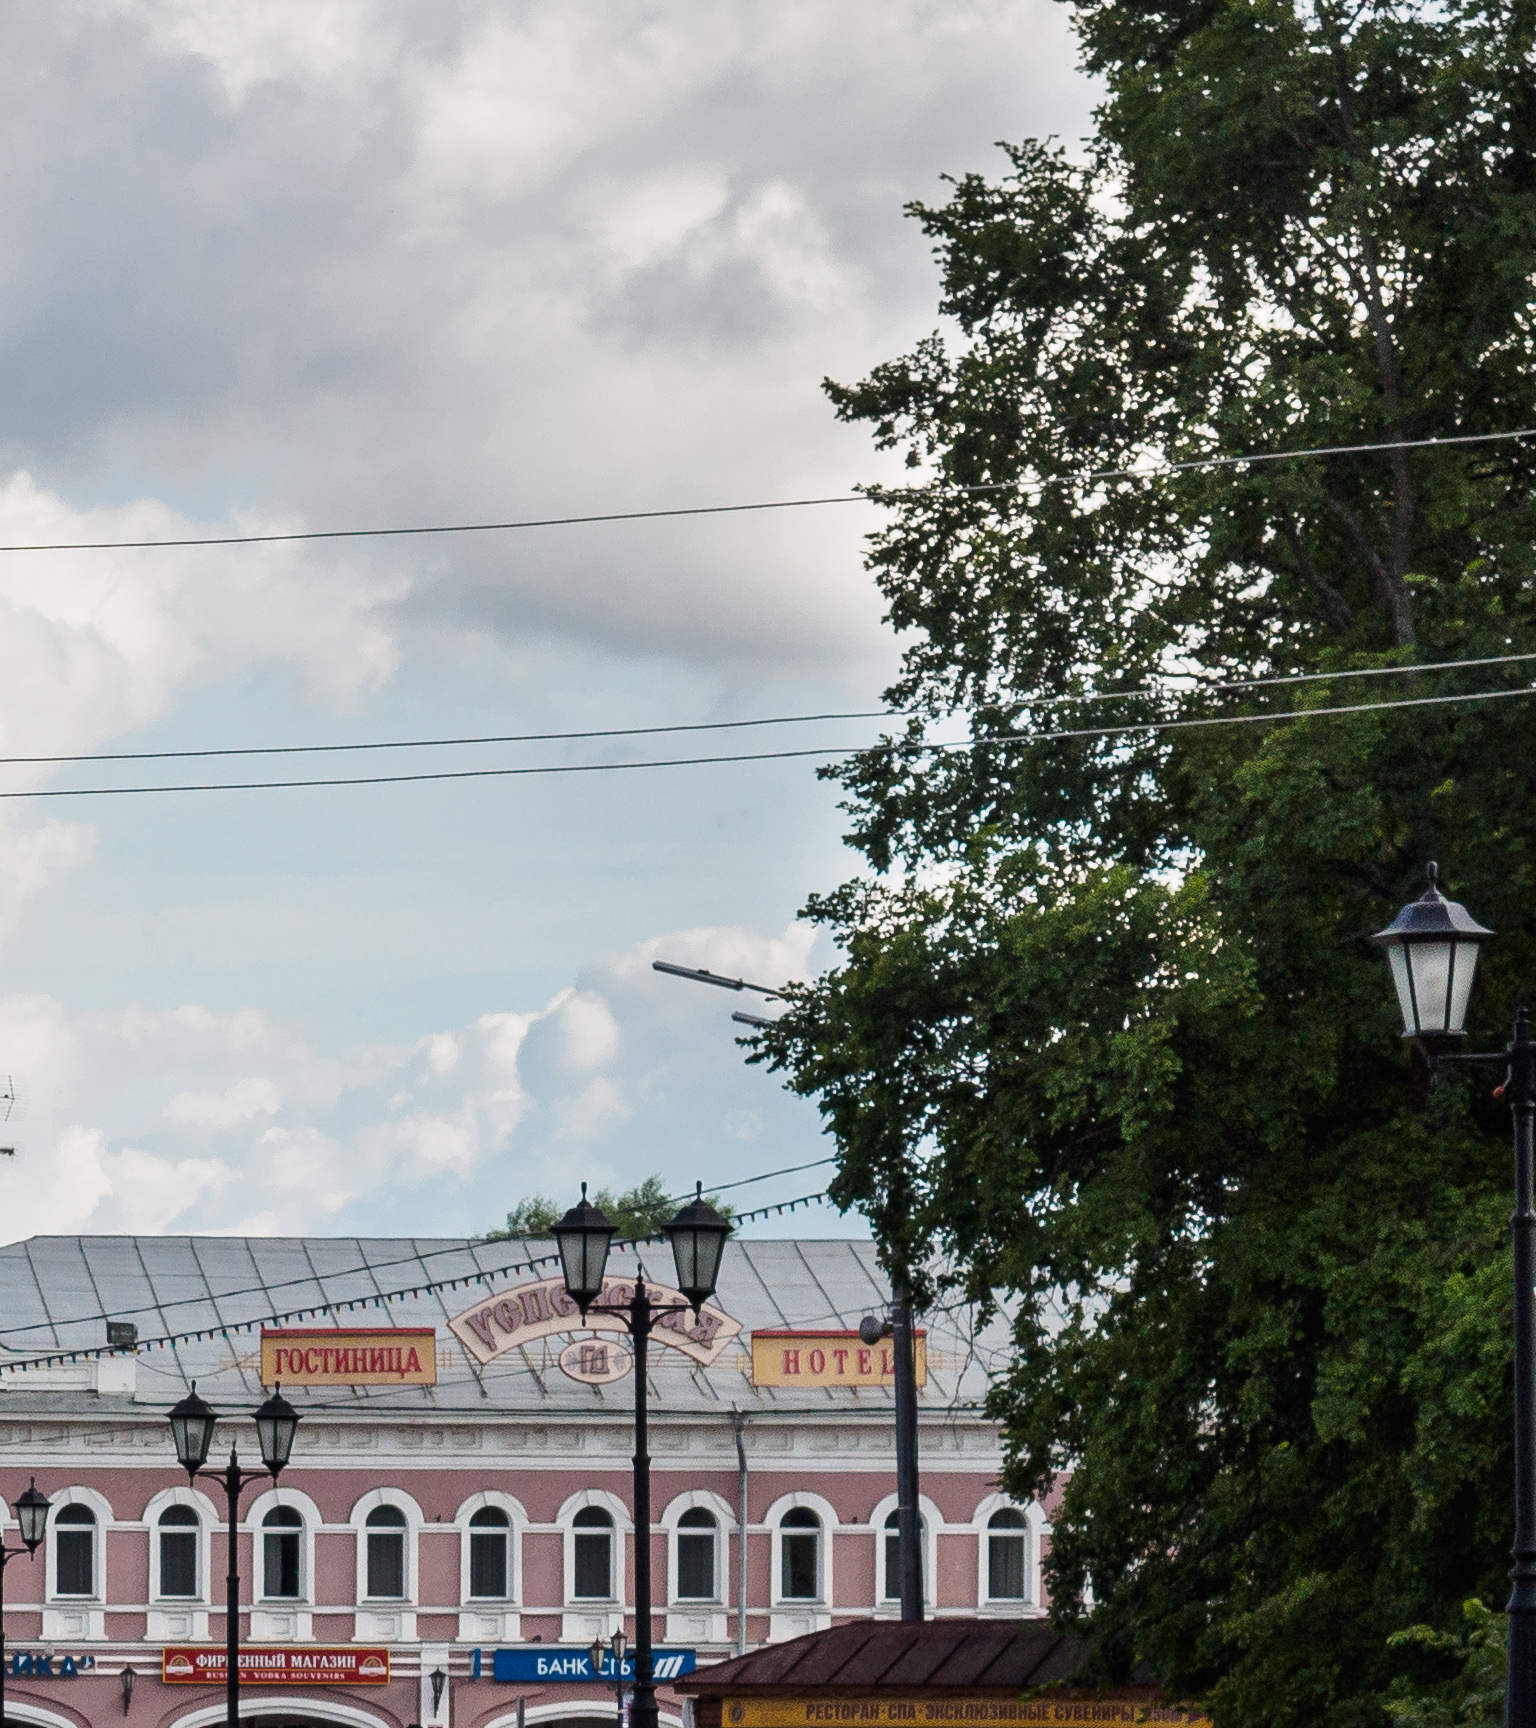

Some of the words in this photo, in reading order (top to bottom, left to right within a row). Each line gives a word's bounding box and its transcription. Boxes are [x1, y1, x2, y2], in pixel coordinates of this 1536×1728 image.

[275, 1346, 422, 1379] ГОСТИНИЦА
[783, 1349, 895, 1375] HOTEL
[195, 1653, 287, 1669] ФИРЕННЫЙ
[291, 1654, 356, 1669] МАГАЗИН
[537, 1657, 589, 1675] БАНК
[805, 1702, 879, 1721] РЕСТОРАН
